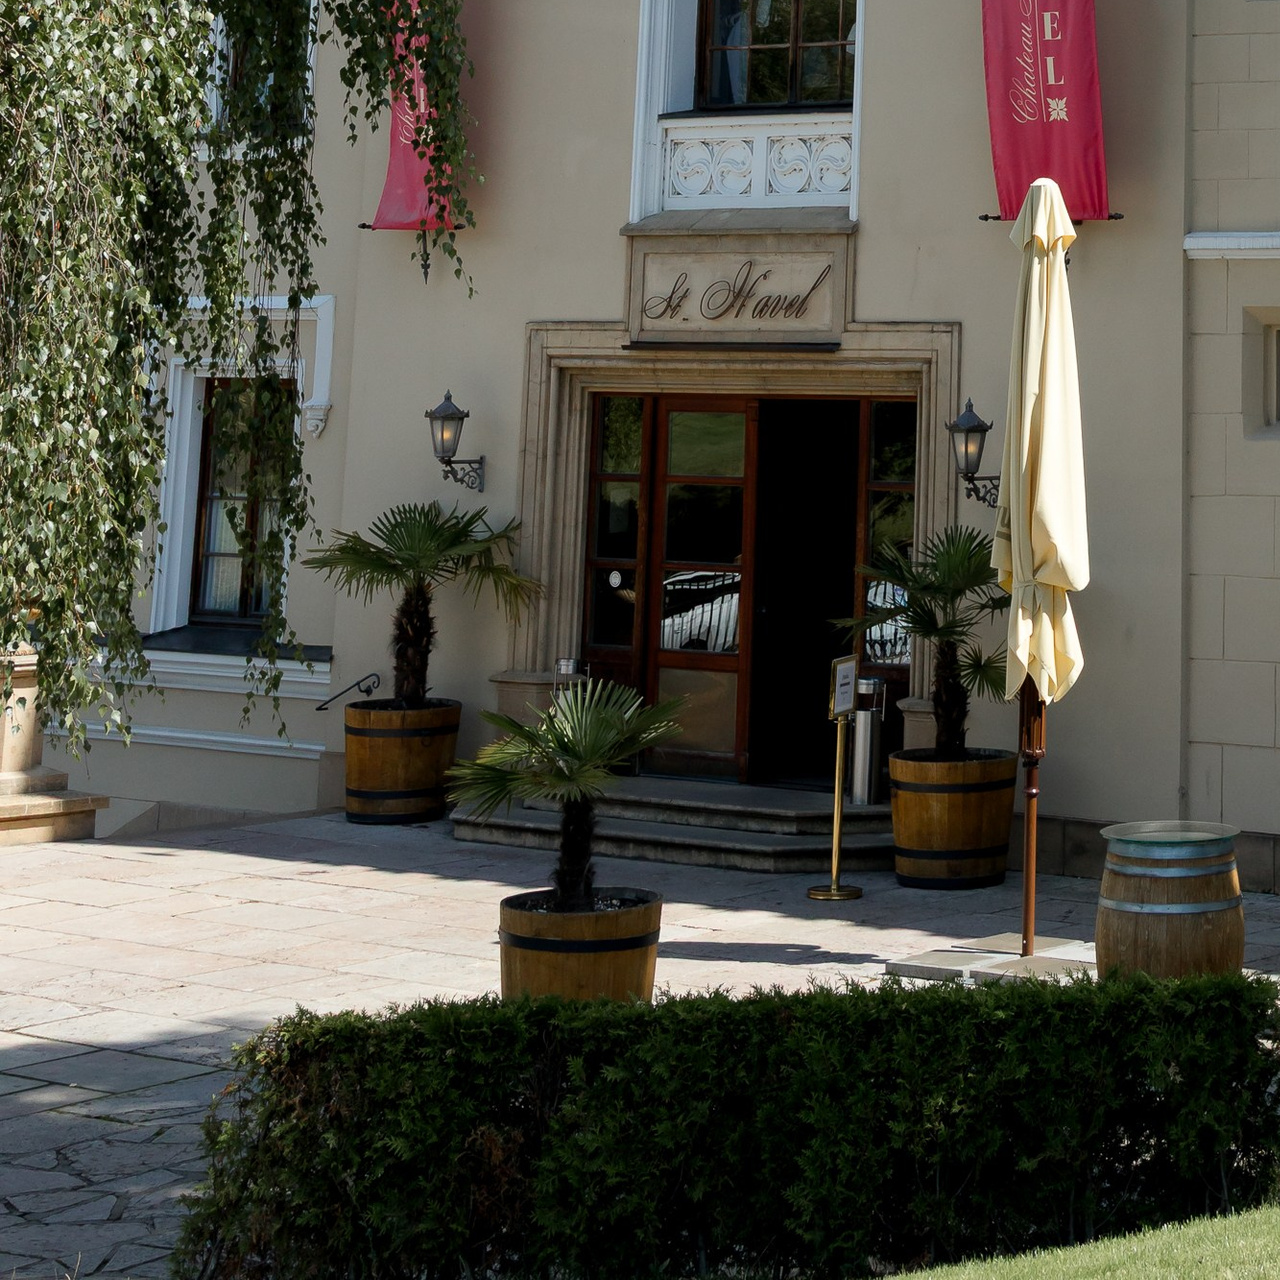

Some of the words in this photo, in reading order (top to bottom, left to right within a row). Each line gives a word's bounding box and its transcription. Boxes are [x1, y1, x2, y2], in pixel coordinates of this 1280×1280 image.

[1008, 20, 1039, 124] Chateau
[643, 272, 690, 321] St.
[700, 260, 832, 320] Havel
